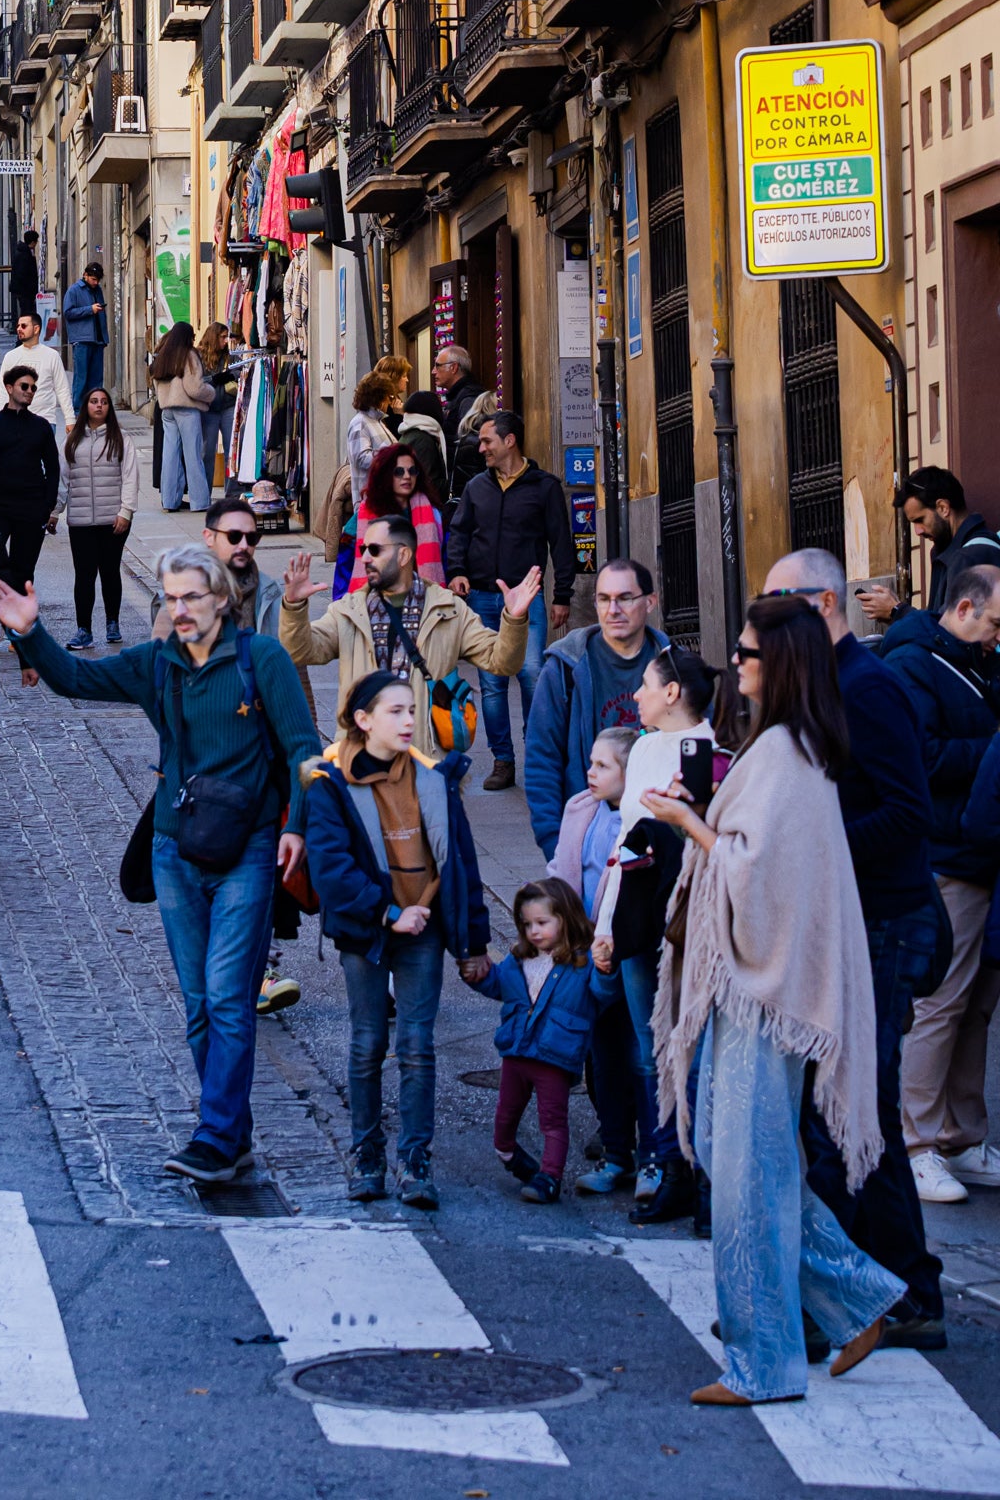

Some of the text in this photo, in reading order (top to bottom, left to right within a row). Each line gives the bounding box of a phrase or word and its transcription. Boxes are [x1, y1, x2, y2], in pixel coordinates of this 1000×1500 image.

[756, 85, 865, 114] ATENCIÓN
[770, 114, 851, 131] CONTROL
[755, 130, 867, 150] POR CÁMARA
[773, 160, 852, 181] CUESTA
[768, 178, 859, 199] GOMÉREZ
[758, 208, 870, 227] EXCEPTO TTE. PÚBLICO Y
[758, 225, 871, 244] VEHÍCULOS AUTORIZADOS
